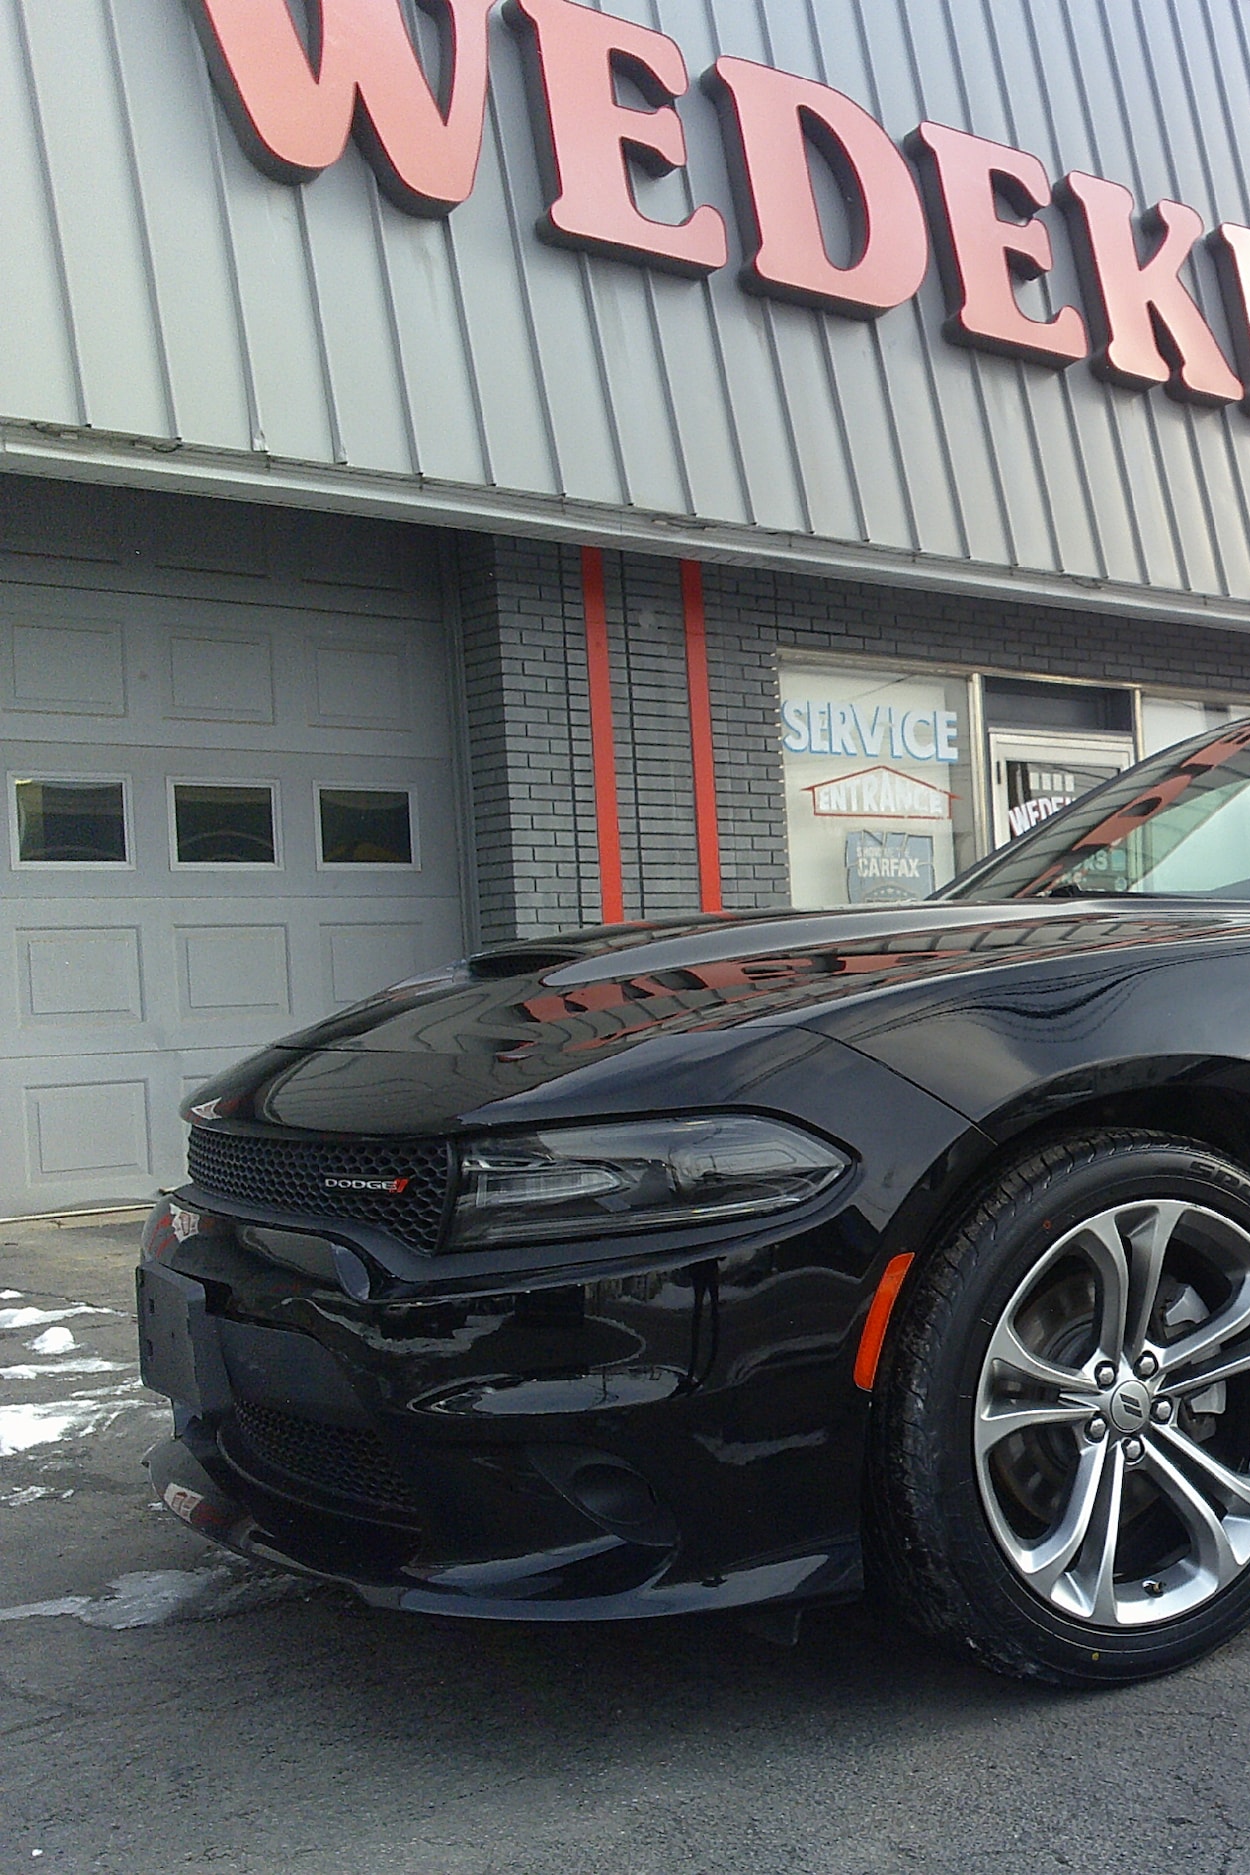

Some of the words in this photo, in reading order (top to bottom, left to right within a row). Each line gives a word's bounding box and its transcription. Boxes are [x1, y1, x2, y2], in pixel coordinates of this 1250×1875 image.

[781, 700, 958, 763] SERVICE
[819, 771, 943, 814] ENTRANCE
[1009, 796, 1076, 836] WEDE
[858, 858, 920, 878] CARFAX
[324, 1178, 397, 1190] DODGE
